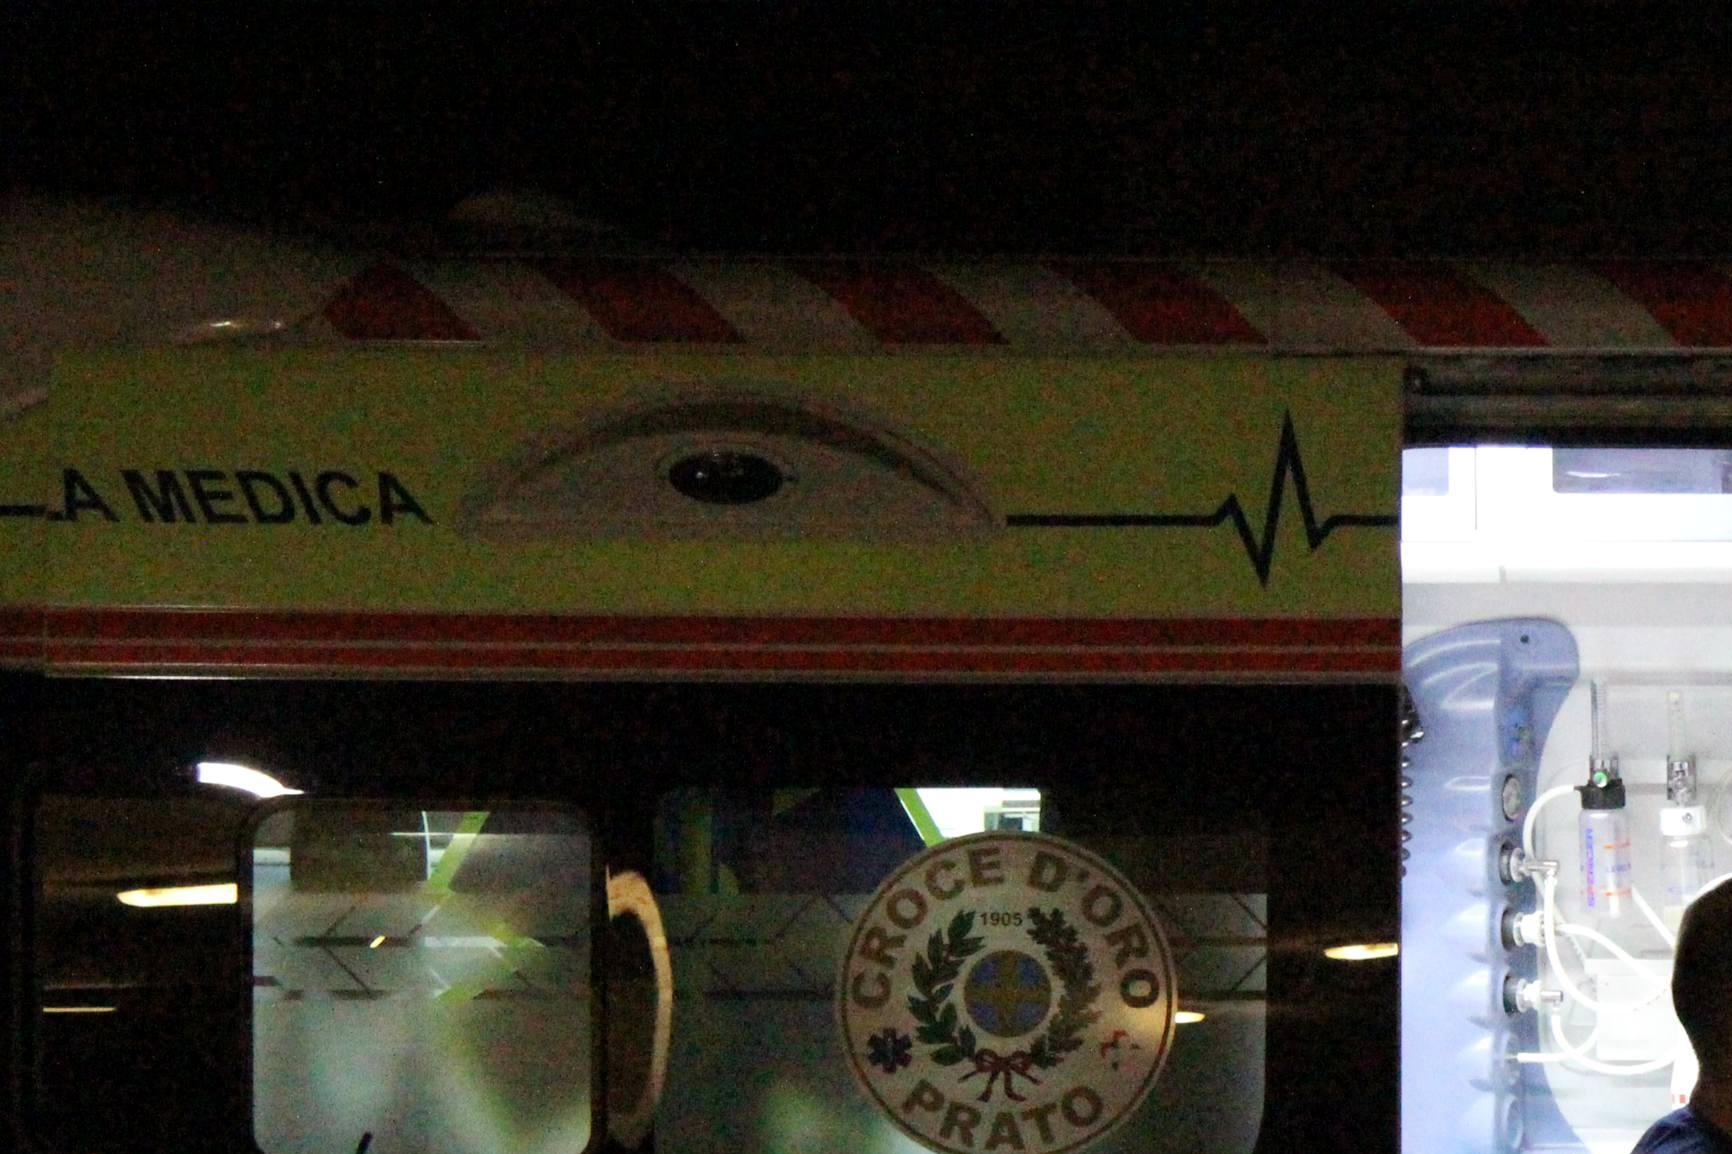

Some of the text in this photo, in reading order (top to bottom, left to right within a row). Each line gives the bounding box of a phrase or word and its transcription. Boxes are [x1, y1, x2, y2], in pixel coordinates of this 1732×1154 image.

[119, 468, 434, 525] MEDICA
[852, 847, 1160, 1009] CROCE D'ORO
[979, 911, 1024, 928] 1905
[902, 1079, 1104, 1152] PRATO
